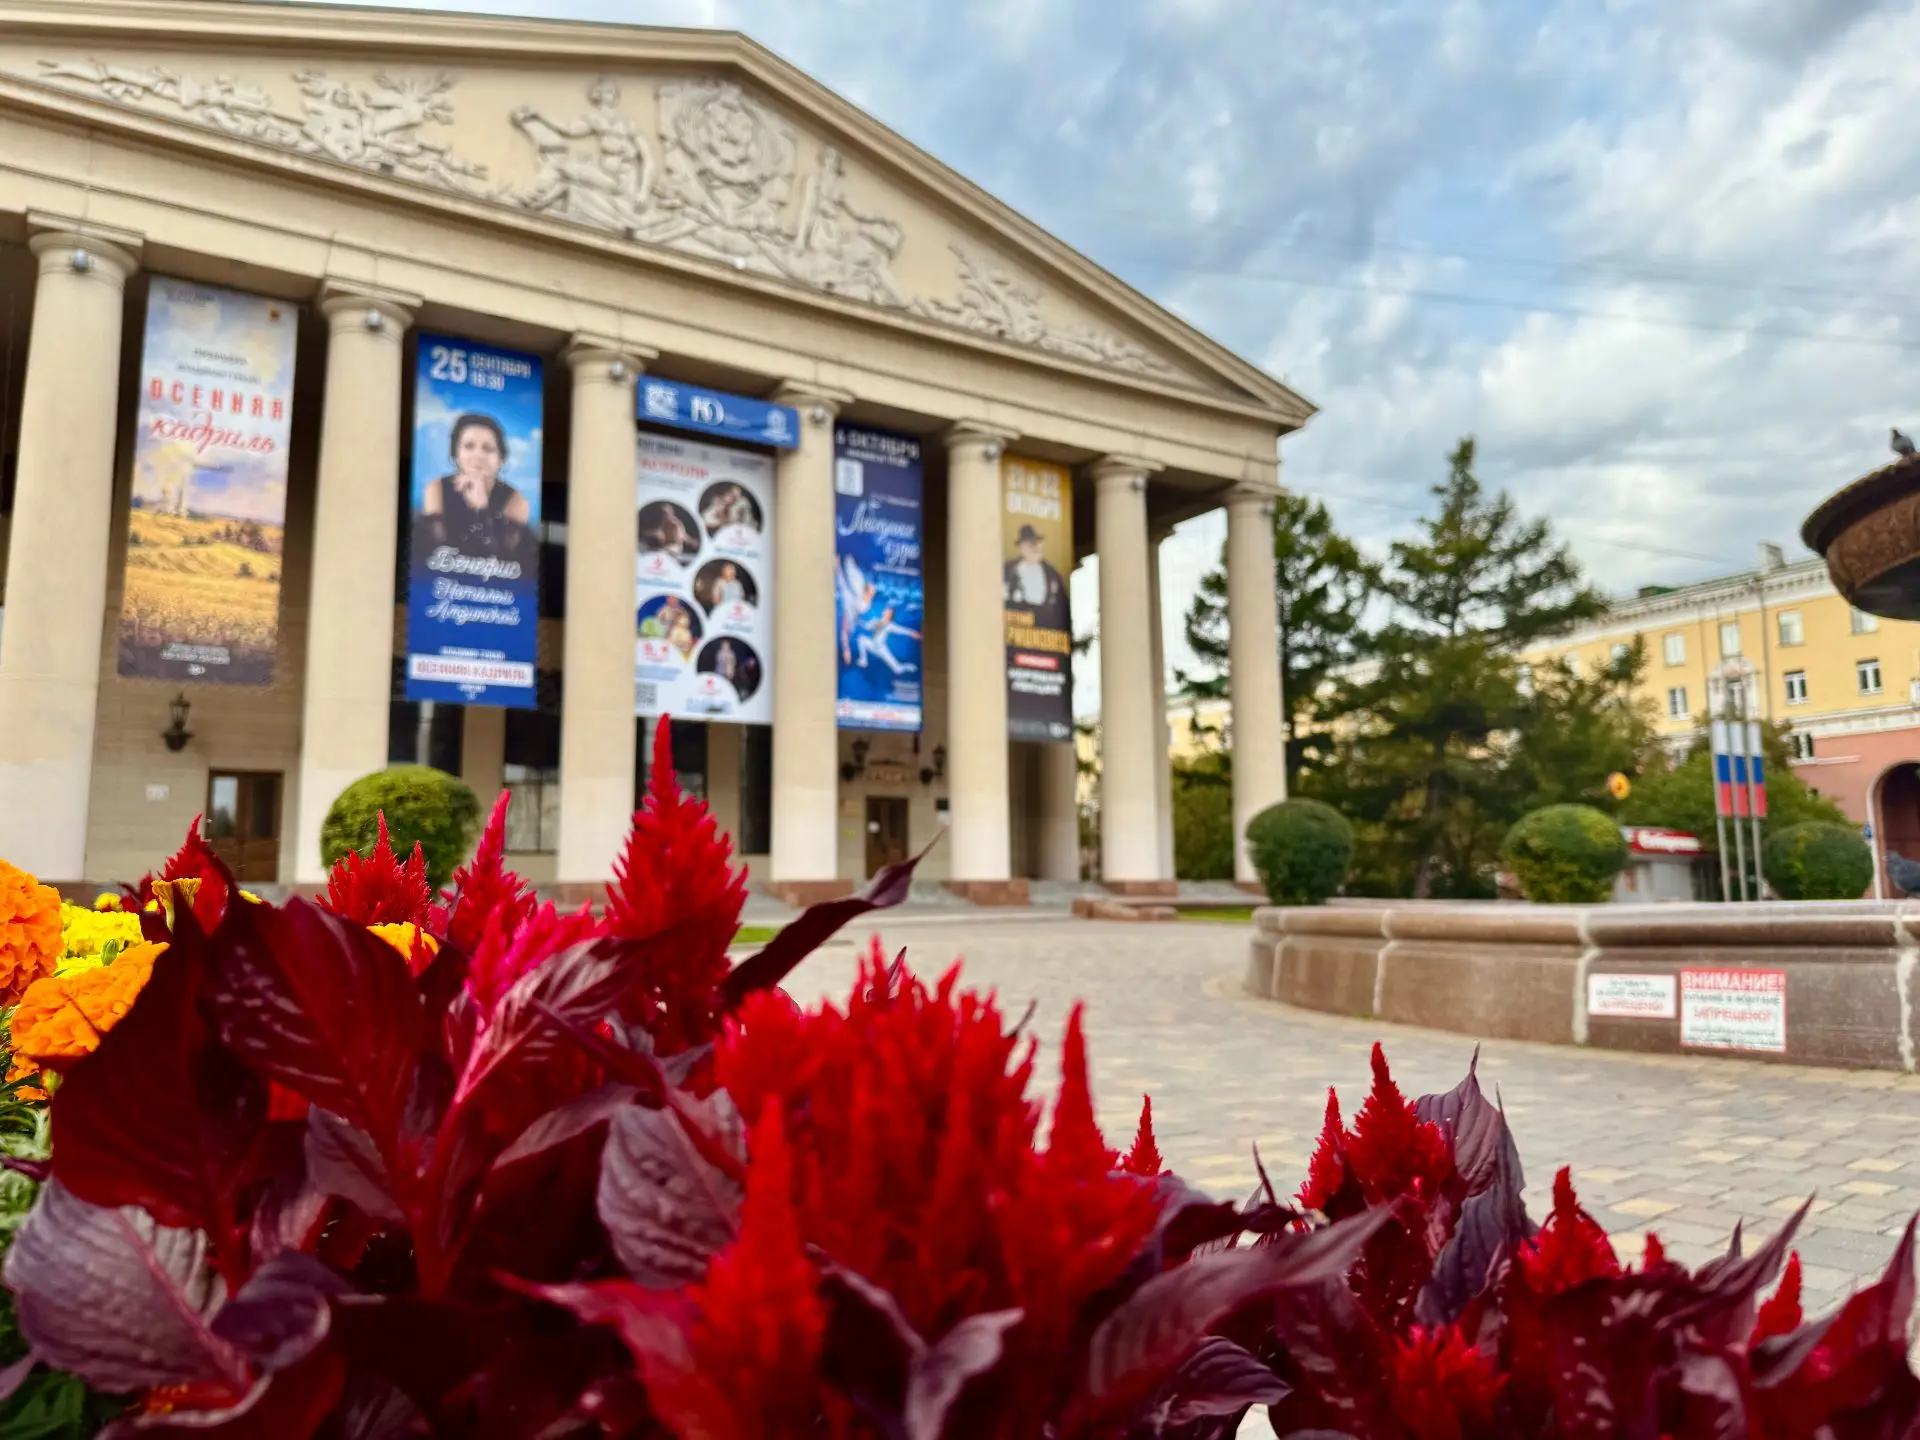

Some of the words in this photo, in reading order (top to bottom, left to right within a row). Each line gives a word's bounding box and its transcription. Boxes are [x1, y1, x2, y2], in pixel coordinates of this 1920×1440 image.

[430, 345, 468, 384] 25
[149, 377, 284, 421] ОСЕННЯЯ
[151, 411, 277, 454] кадриль
[848, 431, 920, 459] ОКТЯБРЯ
[425, 546, 522, 582] Бенефис
[1681, 971, 1786, 991] ВНИМАНИЕ!
